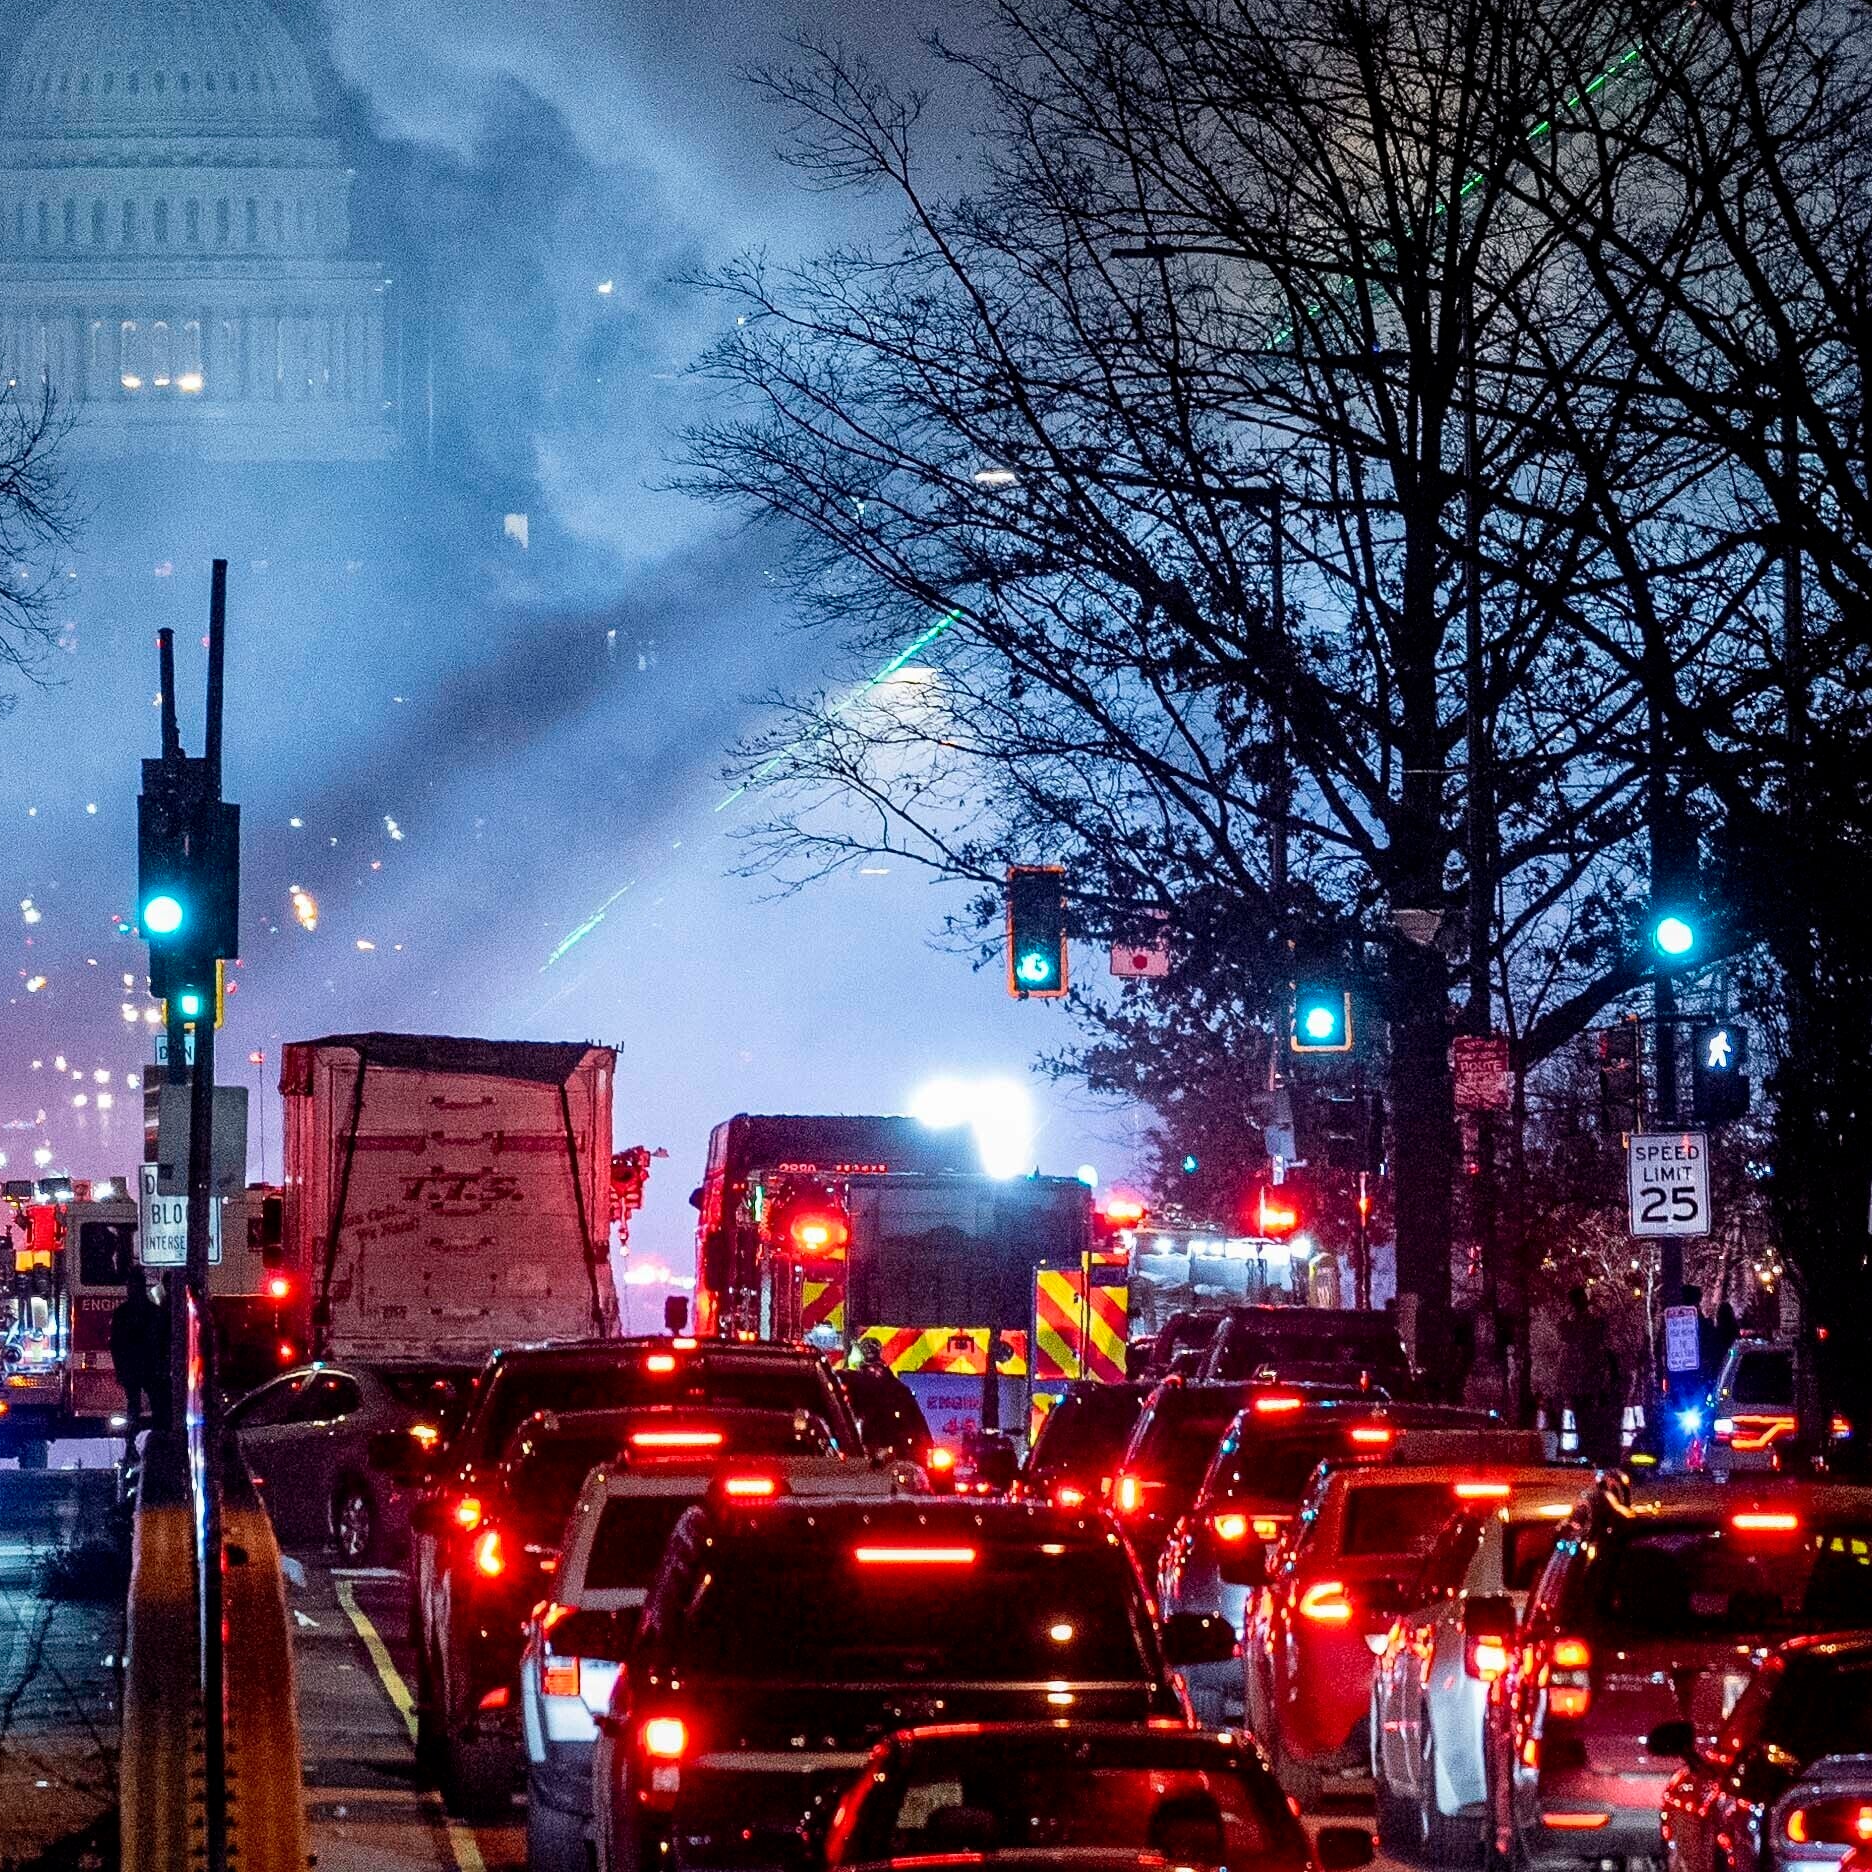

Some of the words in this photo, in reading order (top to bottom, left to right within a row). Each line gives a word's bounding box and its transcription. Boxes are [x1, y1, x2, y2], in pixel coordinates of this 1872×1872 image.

[1636, 1145, 1699, 1161] SPEED
[1644, 1167, 1692, 1182] LIMIT
[152, 1203, 183, 1225] BLO
[1640, 1186, 1699, 1223] 25
